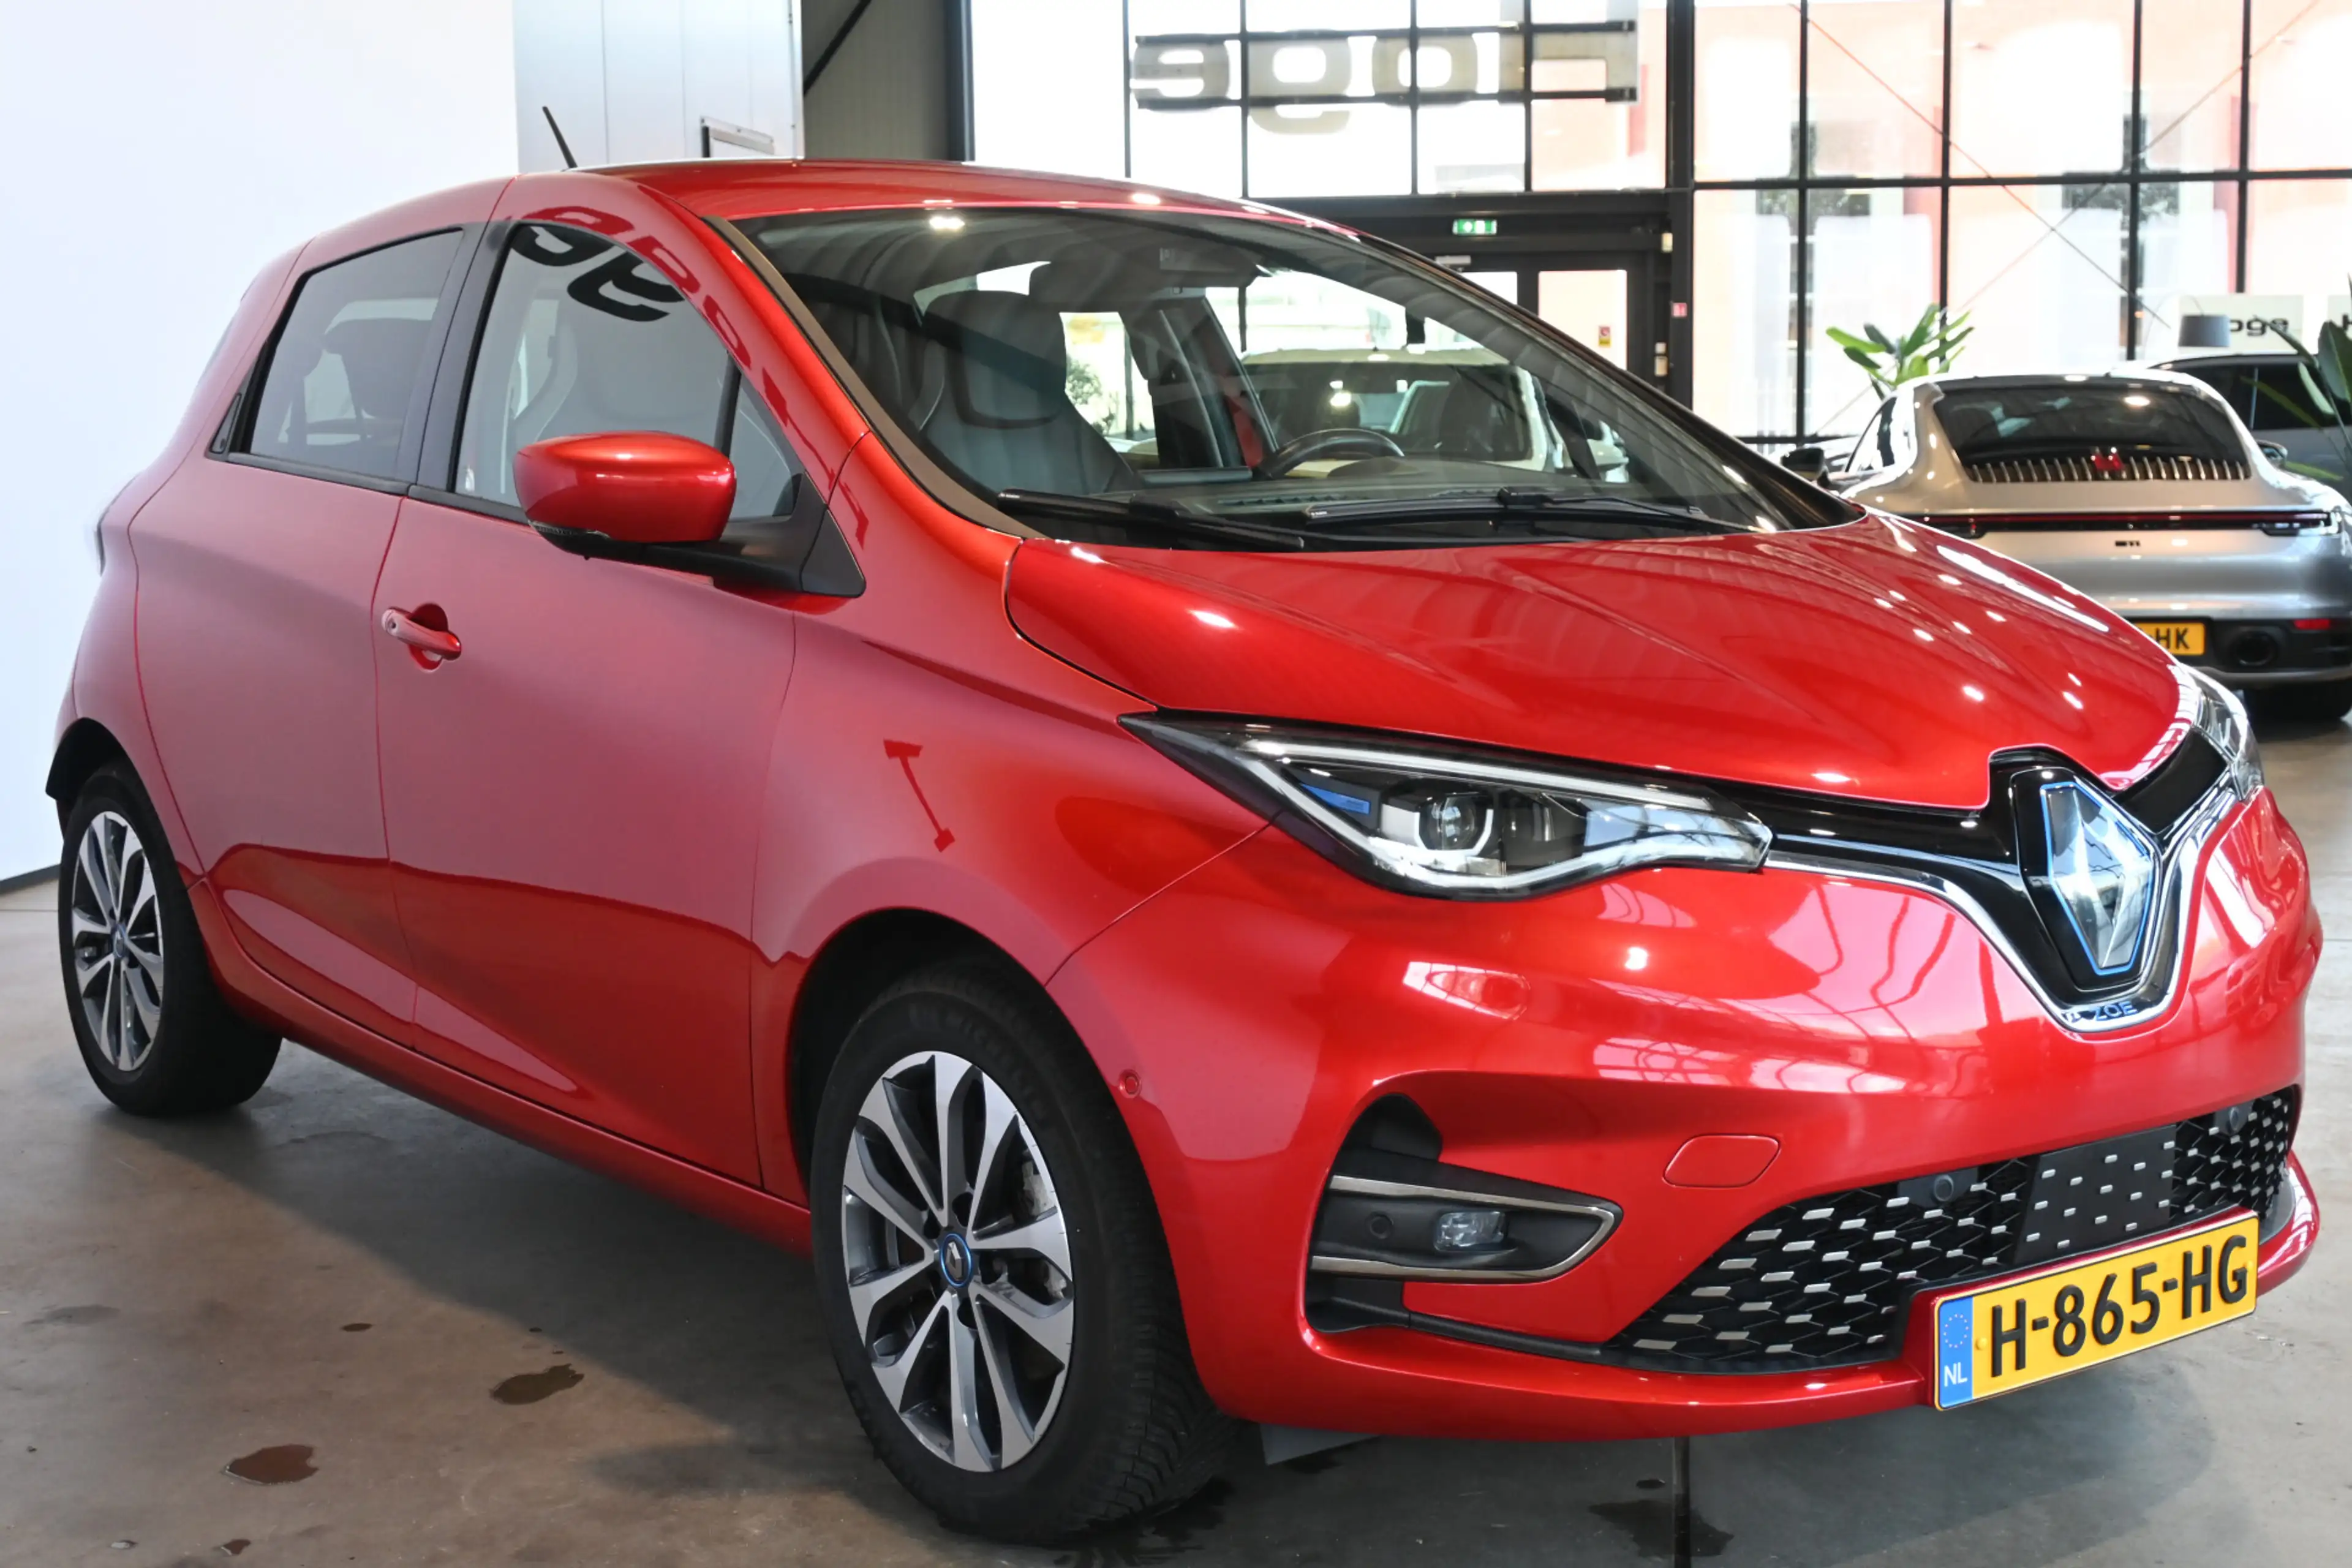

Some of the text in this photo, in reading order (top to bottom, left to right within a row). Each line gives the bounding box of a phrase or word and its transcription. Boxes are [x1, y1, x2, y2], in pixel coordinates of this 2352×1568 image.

[2095, 1001, 2138, 1021] ZOE
[1991, 1234, 2248, 1378] H-865-HG
[1943, 1362, 1968, 1387] NL
